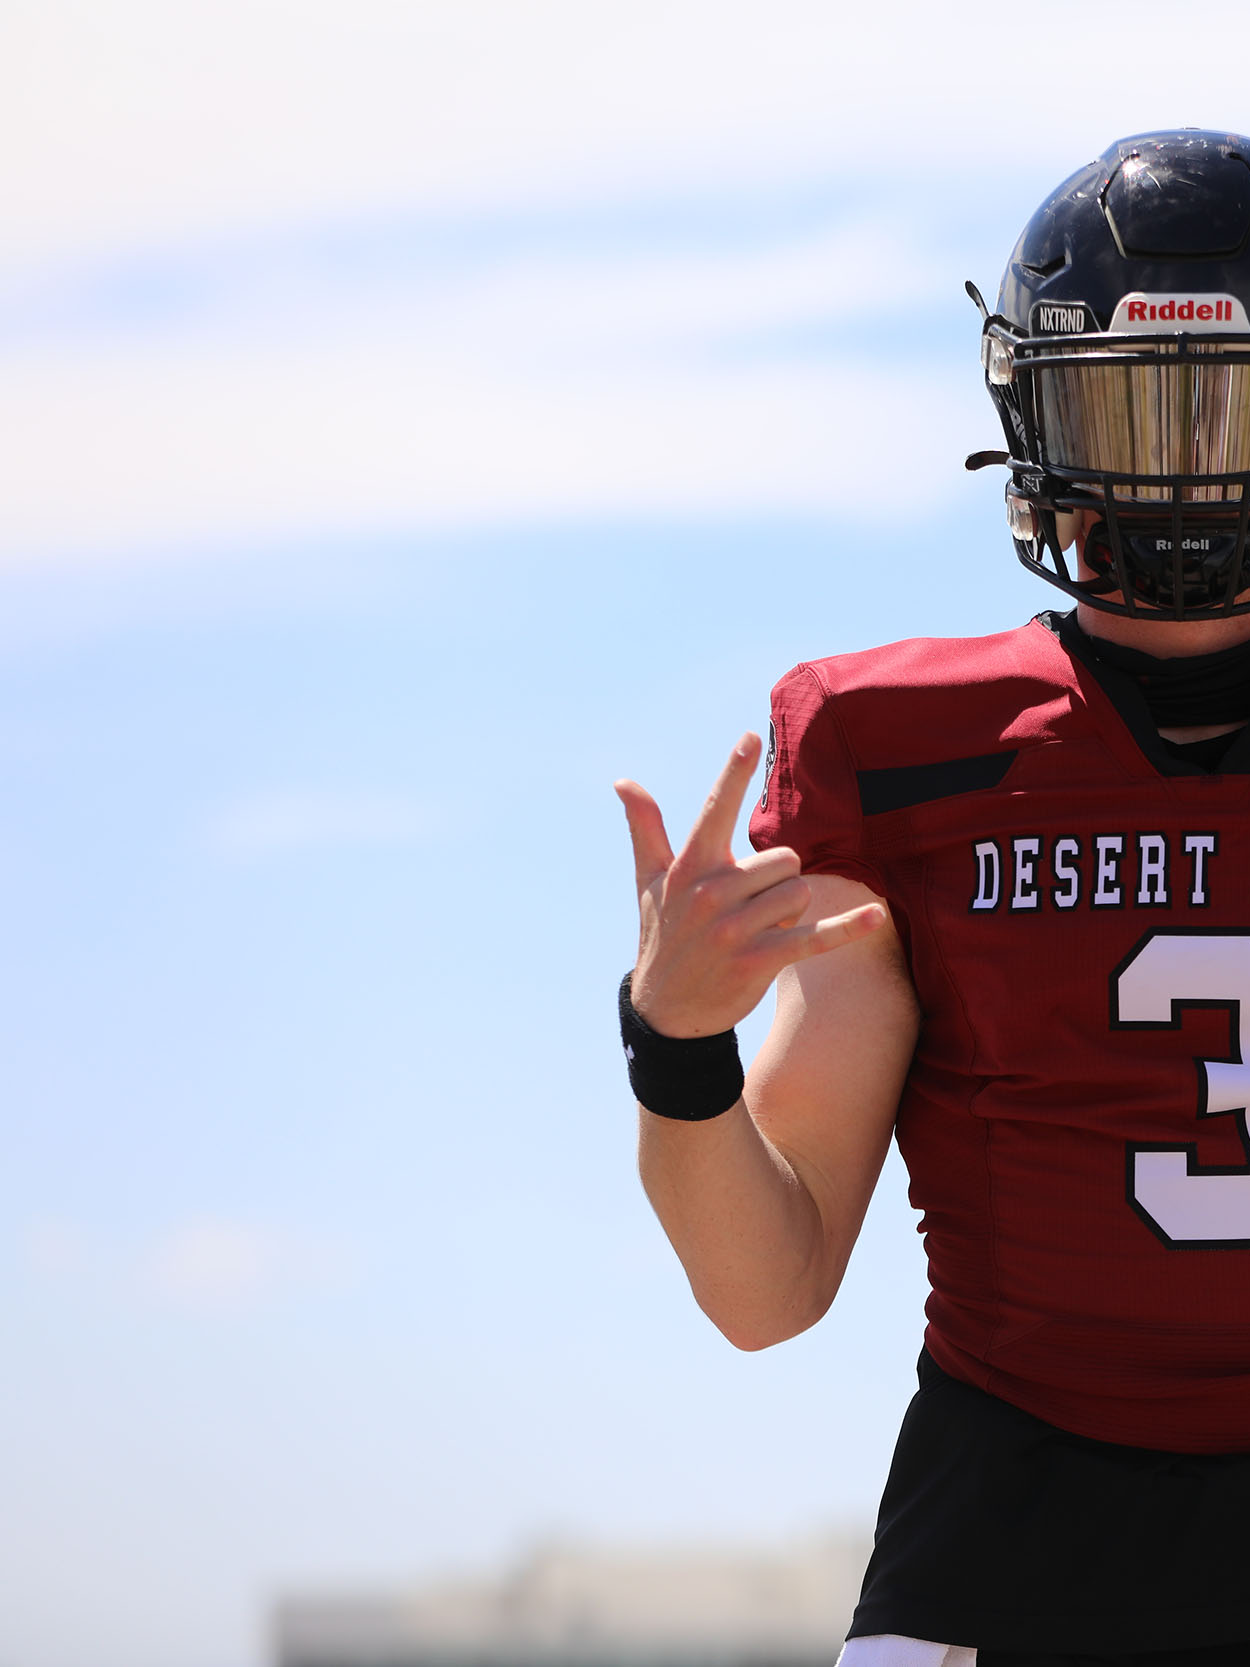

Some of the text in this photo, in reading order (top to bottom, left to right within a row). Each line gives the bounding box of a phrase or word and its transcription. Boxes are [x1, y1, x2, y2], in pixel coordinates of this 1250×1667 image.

[1039, 306, 1085, 334] NXTRND
[1127, 299, 1233, 323] Riddell
[1155, 538, 1210, 551] Ridell
[971, 833, 1217, 911] DESERT
